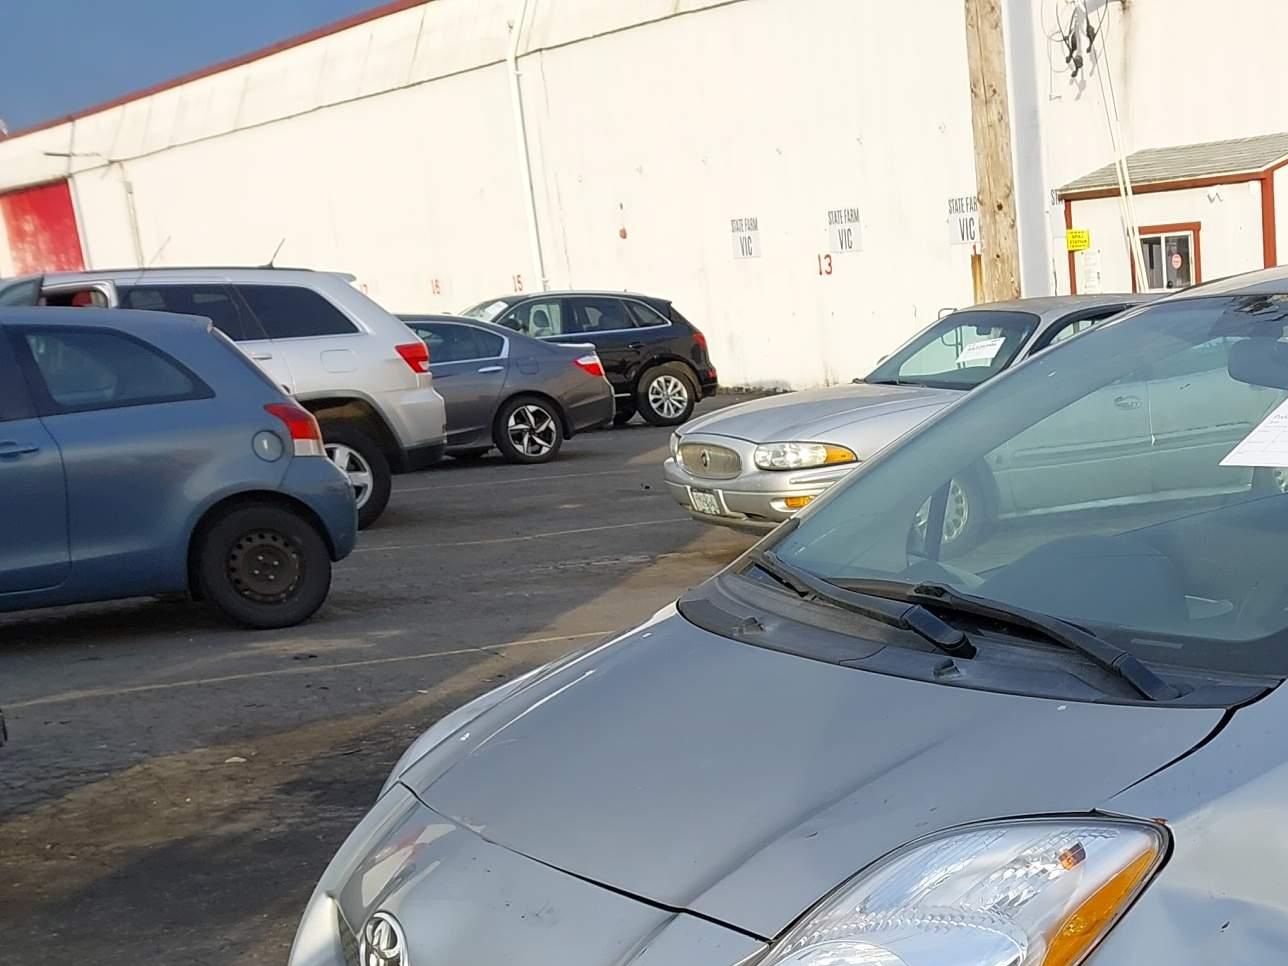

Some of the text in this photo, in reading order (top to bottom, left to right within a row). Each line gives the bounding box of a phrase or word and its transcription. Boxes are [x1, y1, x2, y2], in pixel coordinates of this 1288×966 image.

[948, 196, 977, 215] STATE FAR
[828, 207, 860, 226] STATE FARM
[838, 228, 853, 250] VIC
[959, 217, 976, 241] VIC
[739, 236, 753, 256] VIC
[817, 253, 833, 276] 13
[512, 274, 523, 293] 15
